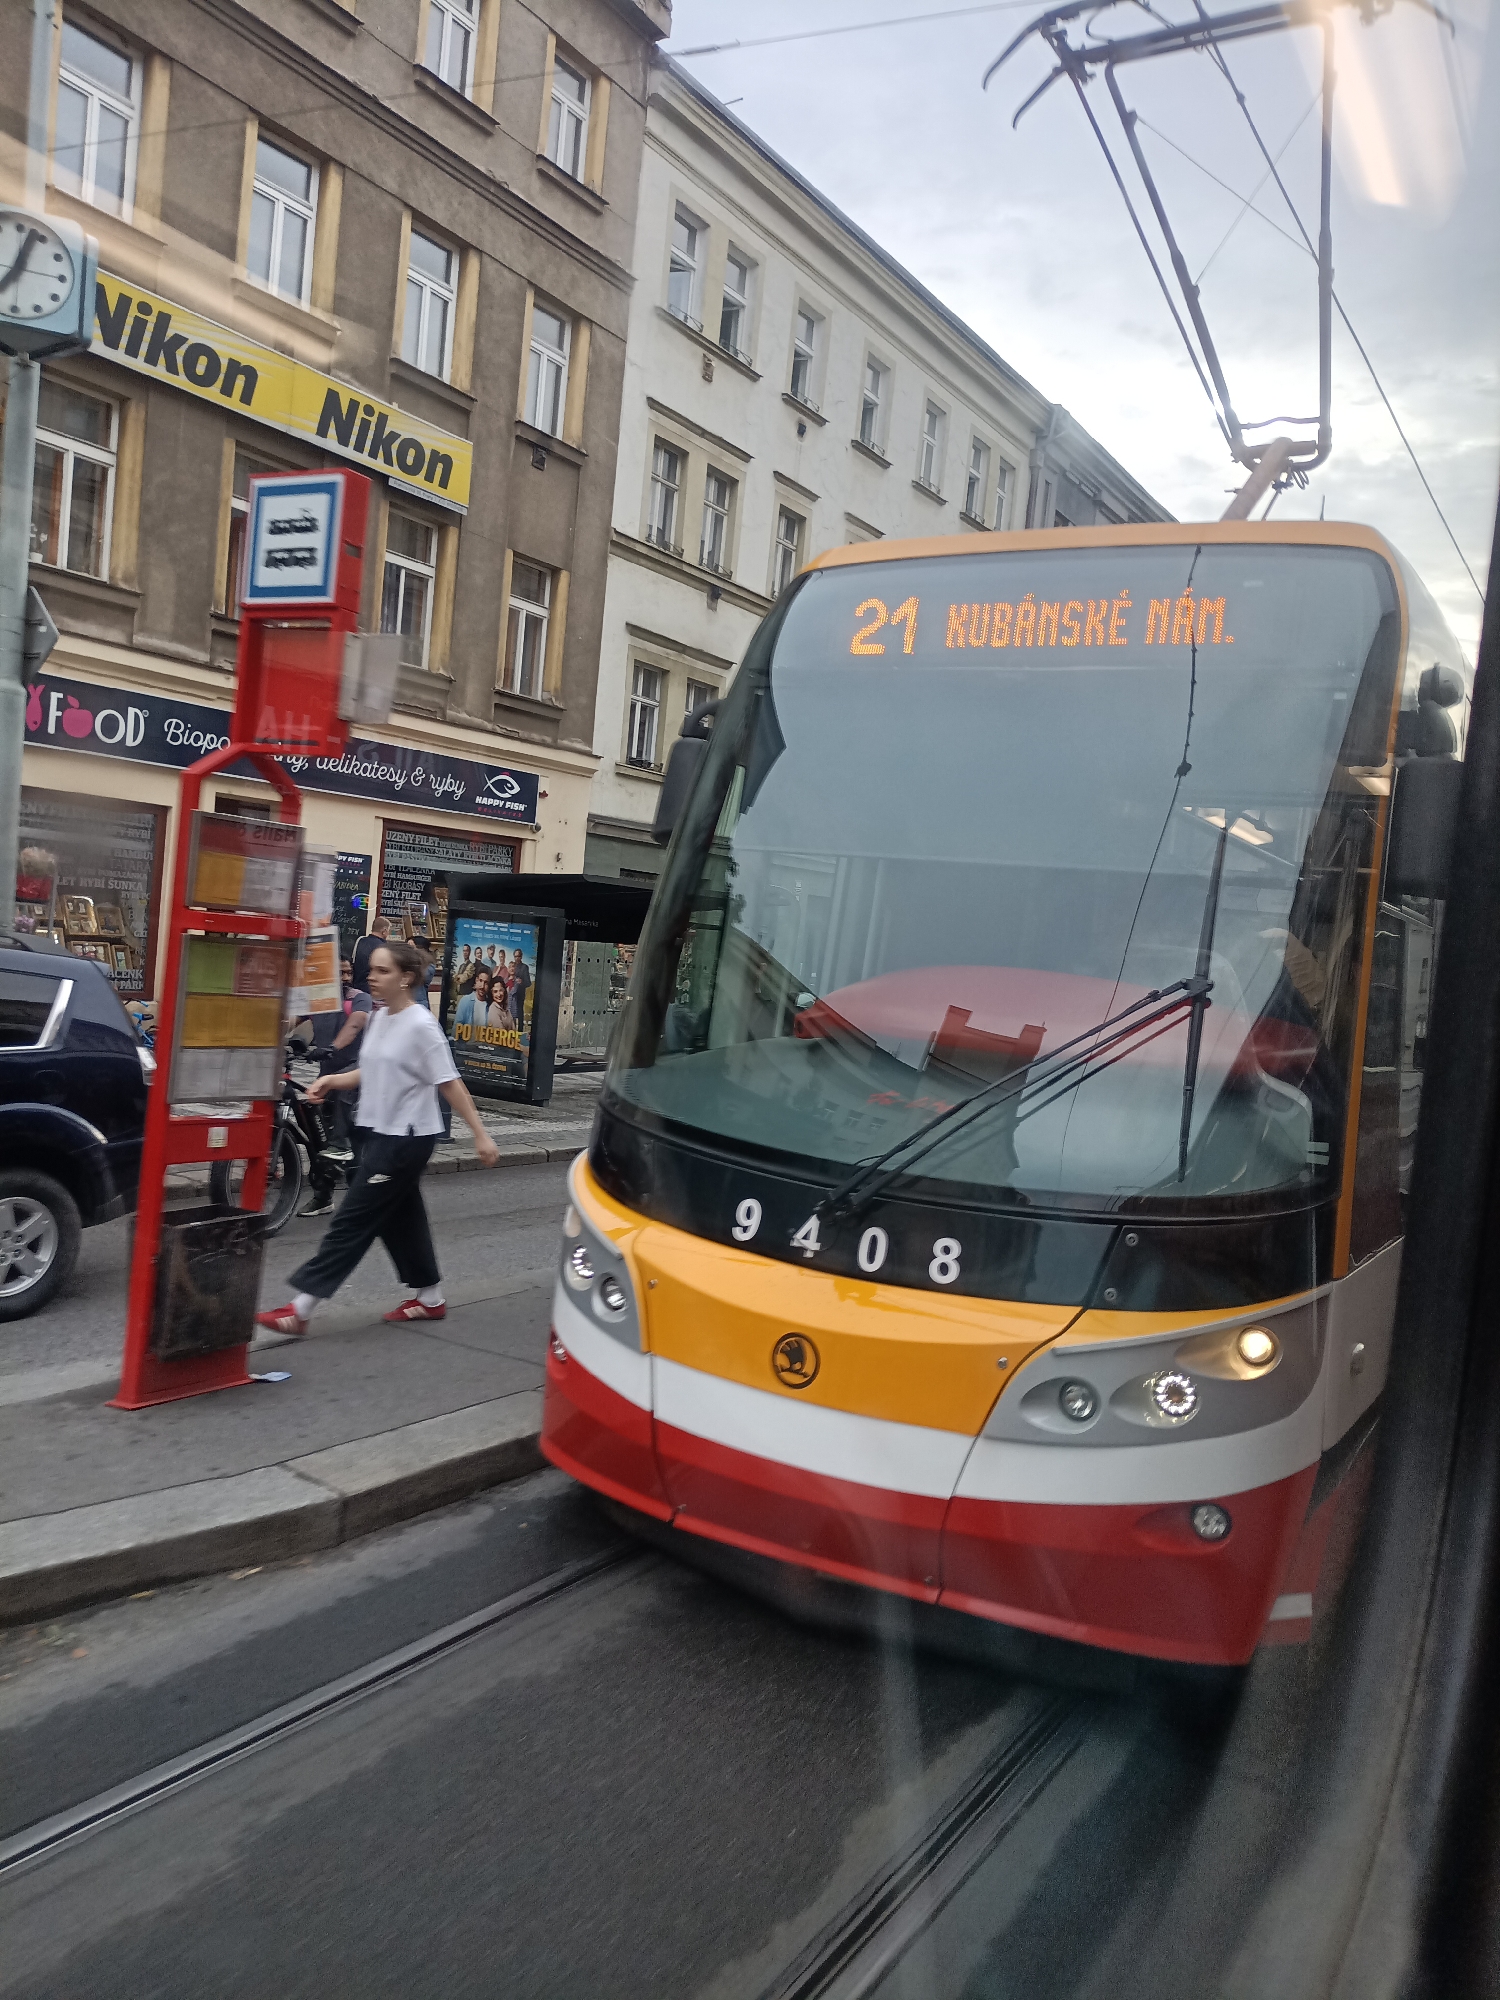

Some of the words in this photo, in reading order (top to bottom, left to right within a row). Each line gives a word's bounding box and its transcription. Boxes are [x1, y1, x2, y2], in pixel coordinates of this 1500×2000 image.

[96, 281, 259, 407] Nikon
[315, 387, 454, 490] Nikon
[849, 596, 920, 655] 21
[944, 588, 1133, 648] KUBÁNSKÉ
[1144, 587, 1234, 645] NÁM.
[410, 766, 426, 787] &
[429, 773, 467, 800] ryby
[475, 795, 504, 807] HAPPY
[505, 801, 525, 811] FISH
[415, 835, 440, 847] FILET
[108, 878, 144, 891] ŠUNKA
[400, 891, 422, 900] FILET
[454, 1022, 472, 1041] PO
